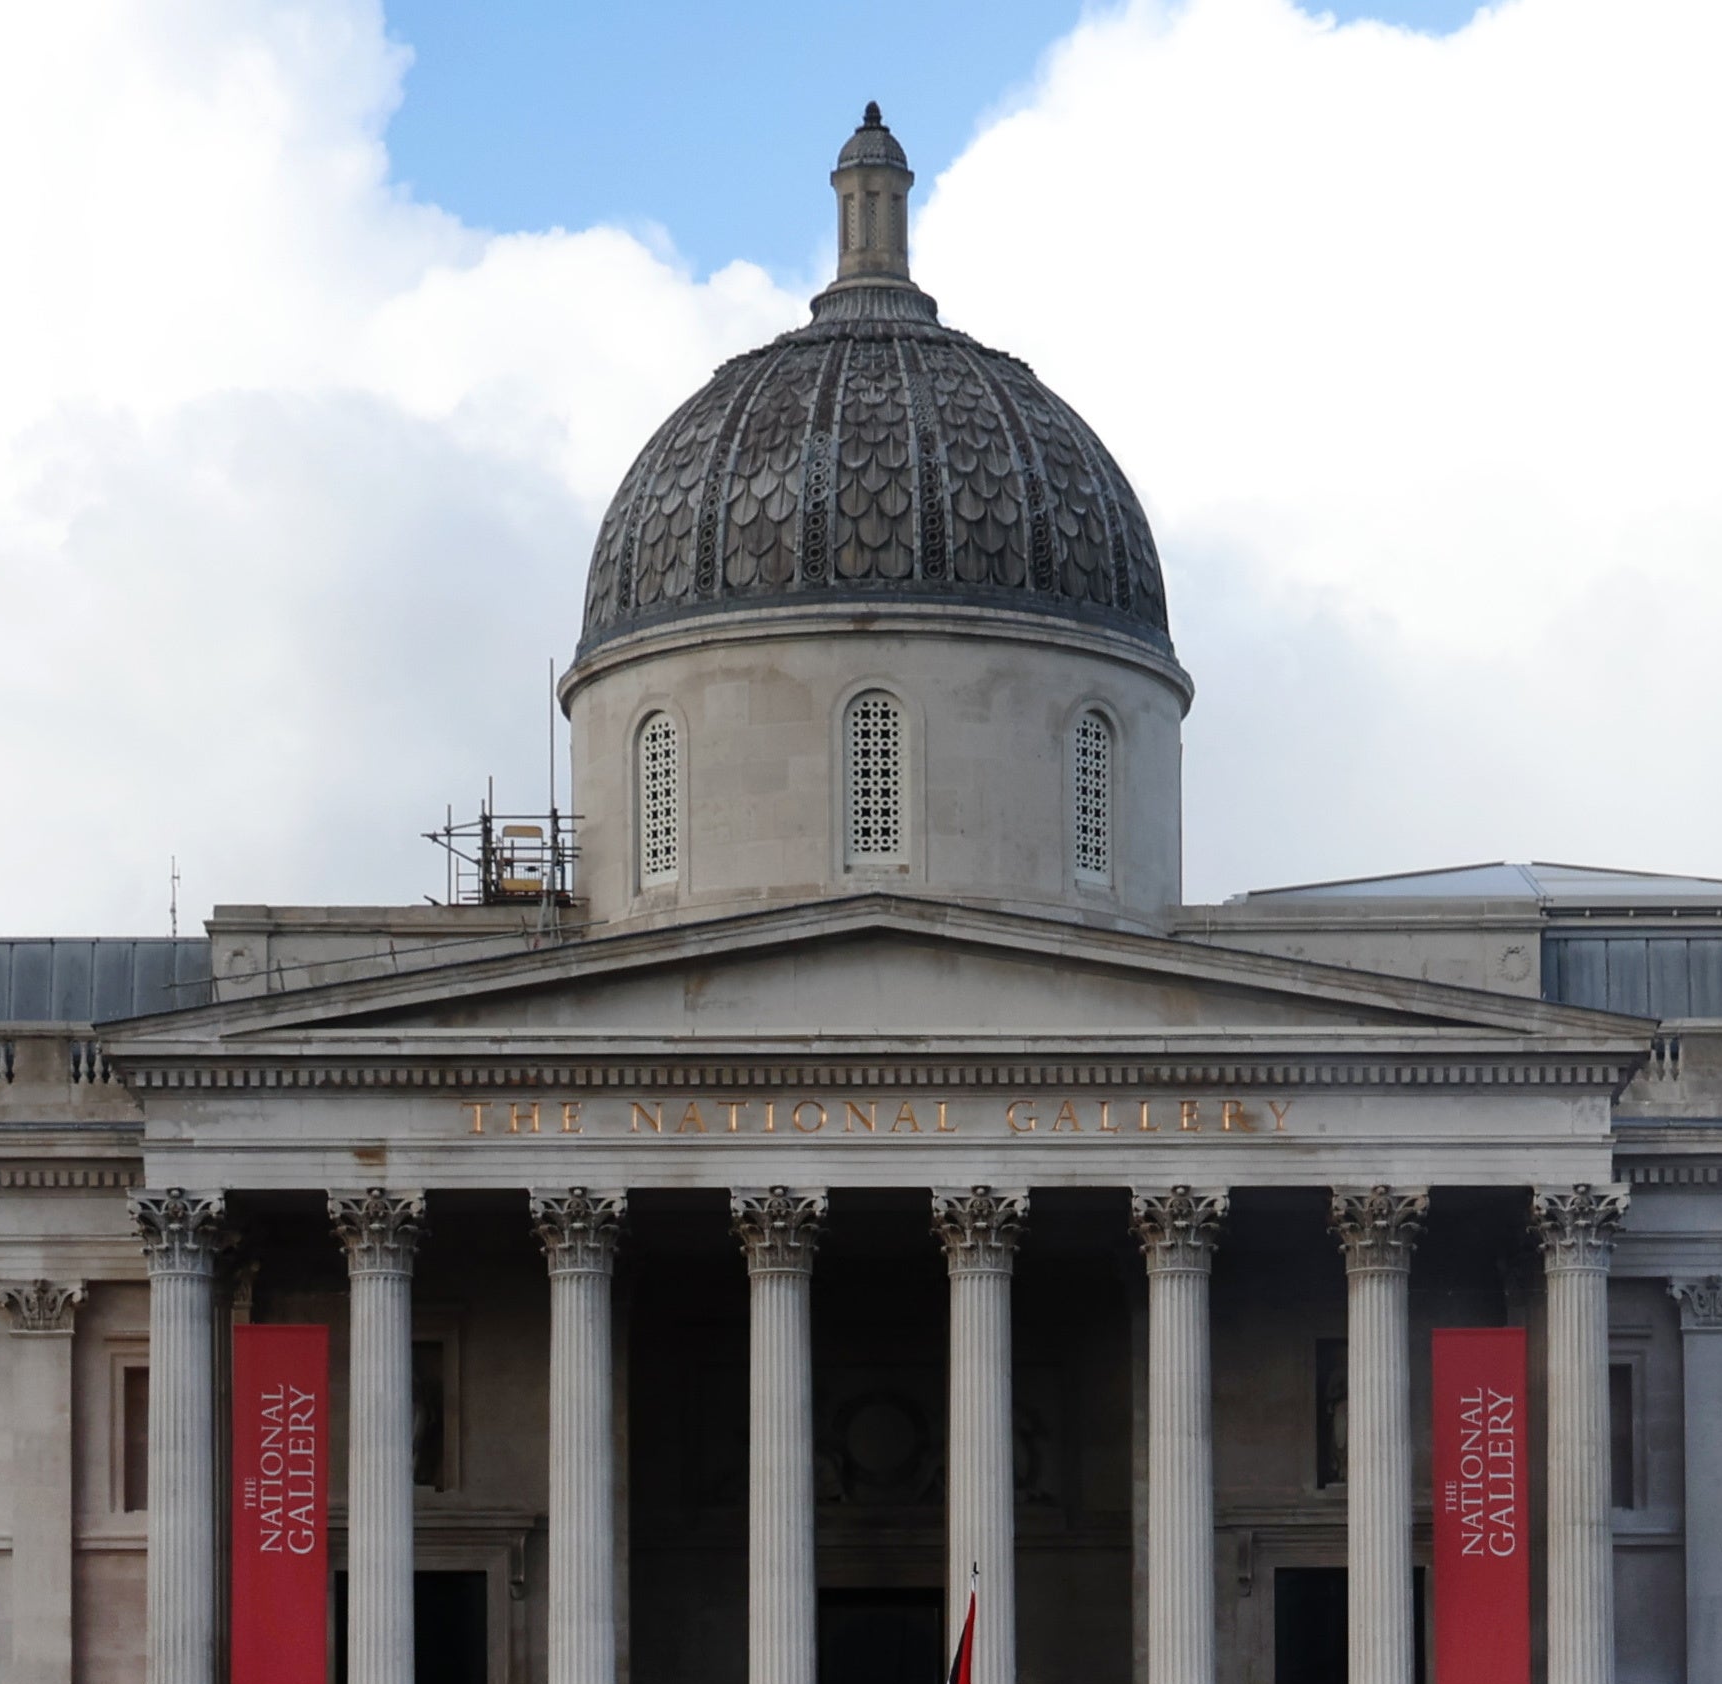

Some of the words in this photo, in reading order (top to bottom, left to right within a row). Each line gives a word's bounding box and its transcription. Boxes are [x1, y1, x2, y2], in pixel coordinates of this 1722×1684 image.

[461, 1101, 582, 1135] THE
[628, 1101, 959, 1135] NATIONAL
[1006, 1101, 1294, 1135] GALLERY
[244, 1476, 255, 1508] THE
[260, 1385, 284, 1554] NATIONAL
[288, 1385, 316, 1555] GALLERY
[1446, 1479, 1457, 1511] THE
[1460, 1388, 1484, 1556] NATIONAL
[1488, 1388, 1515, 1556] GALLERY
